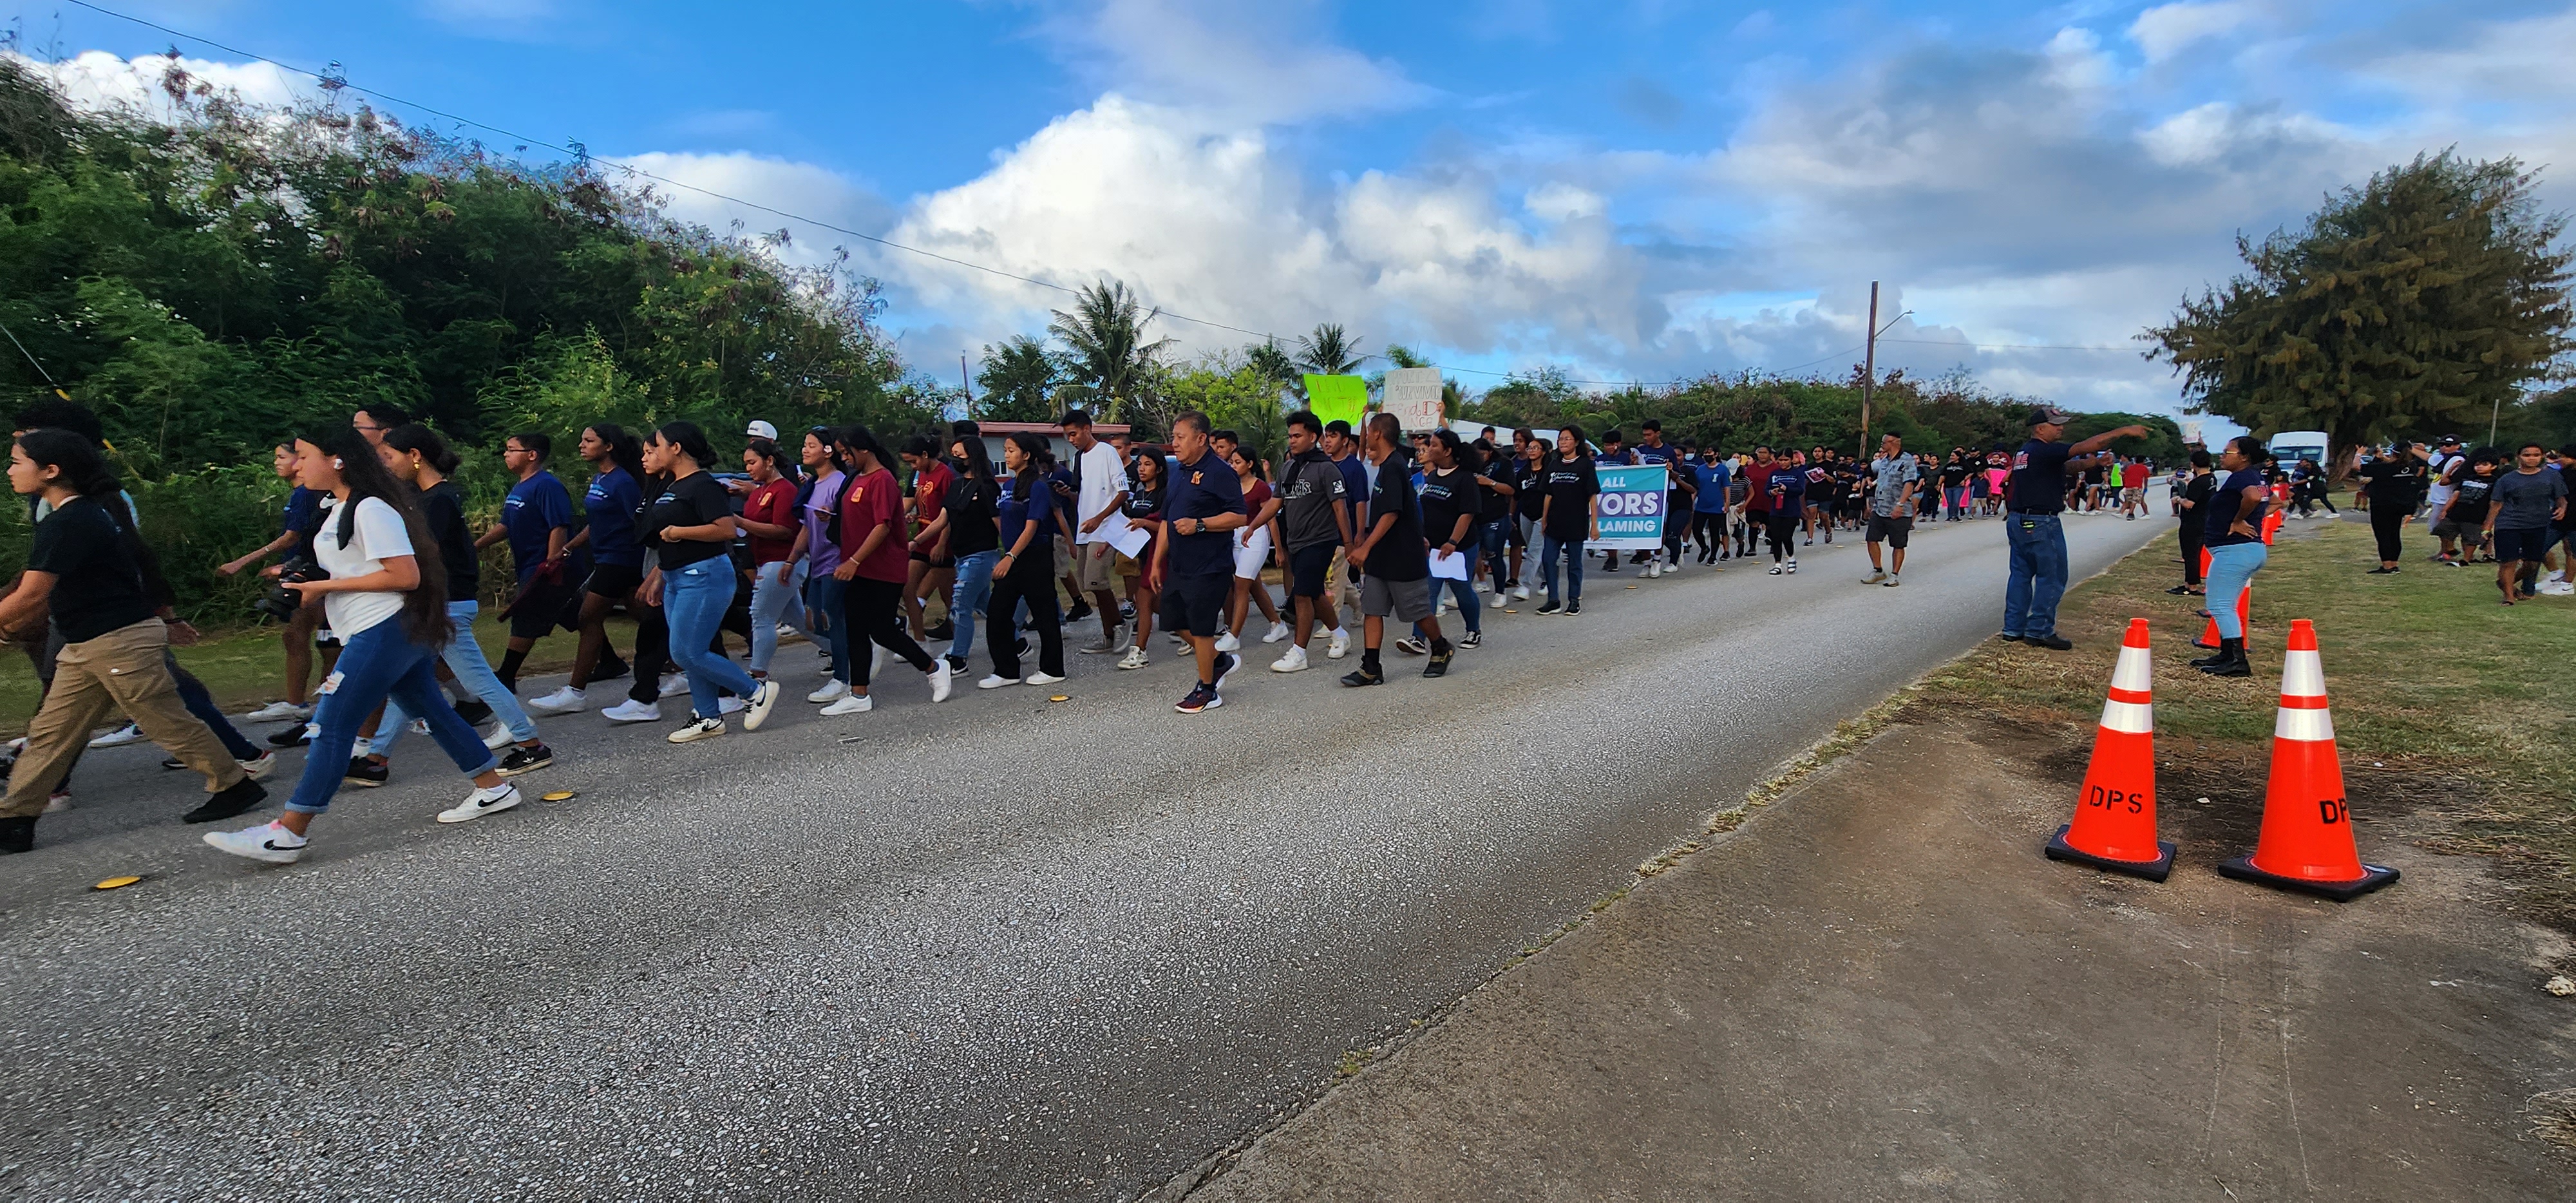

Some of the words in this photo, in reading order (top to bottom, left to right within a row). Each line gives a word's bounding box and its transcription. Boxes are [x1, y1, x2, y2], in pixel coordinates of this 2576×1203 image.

[1601, 477, 1626, 488] ALL
[1598, 520, 1656, 532] LAMING
[2089, 785, 2143, 814] DPS
[2320, 797, 2347, 824] DP
